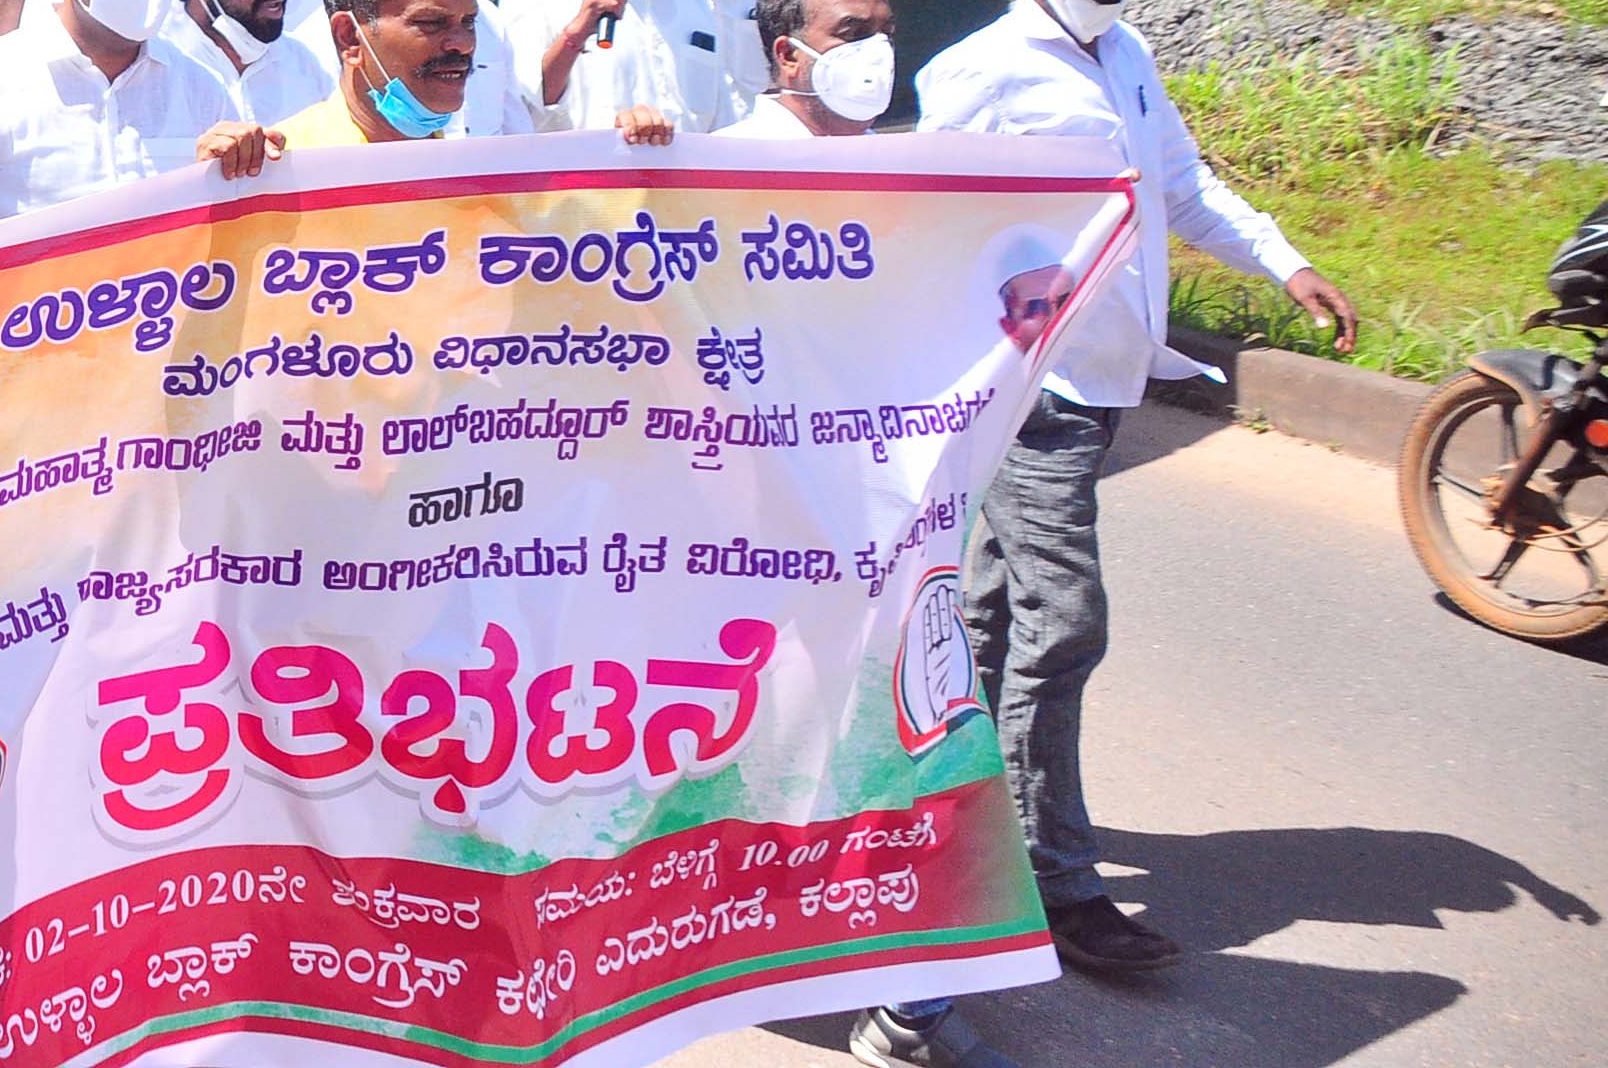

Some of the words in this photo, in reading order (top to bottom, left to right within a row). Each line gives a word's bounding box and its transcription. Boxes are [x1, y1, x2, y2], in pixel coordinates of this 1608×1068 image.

[263, 229, 447, 314] ಬ್ಲಾಕ್
[478, 211, 718, 302] ಕಾಂಗ್ರೆಸ್
[742, 214, 875, 283] ಸಮಿತಿ
[162, 331, 414, 397] ಮಂಗಳೂರು
[433, 324, 670, 372] ವಿಧಾನಸಭಾ
[696, 326, 765, 390] ಕ್ಷೇತ್ರ
[282, 410, 363, 470] ಮತ್ತು
[408, 471, 524, 528] ಹಾಗೂ
[603, 532, 667, 592] ರೈತ
[97, 617, 778, 832] ಪ್ರತಿಭಟನೆ
[736, 839, 830, 872] 10.00
[146, 932, 260, 1002] ಬ್ಲಾಕ್
[288, 942, 469, 1010] ಕಾಂಗ್ರೆಸ್
[798, 862, 921, 929] ಕಲ್ಲಾಪು
